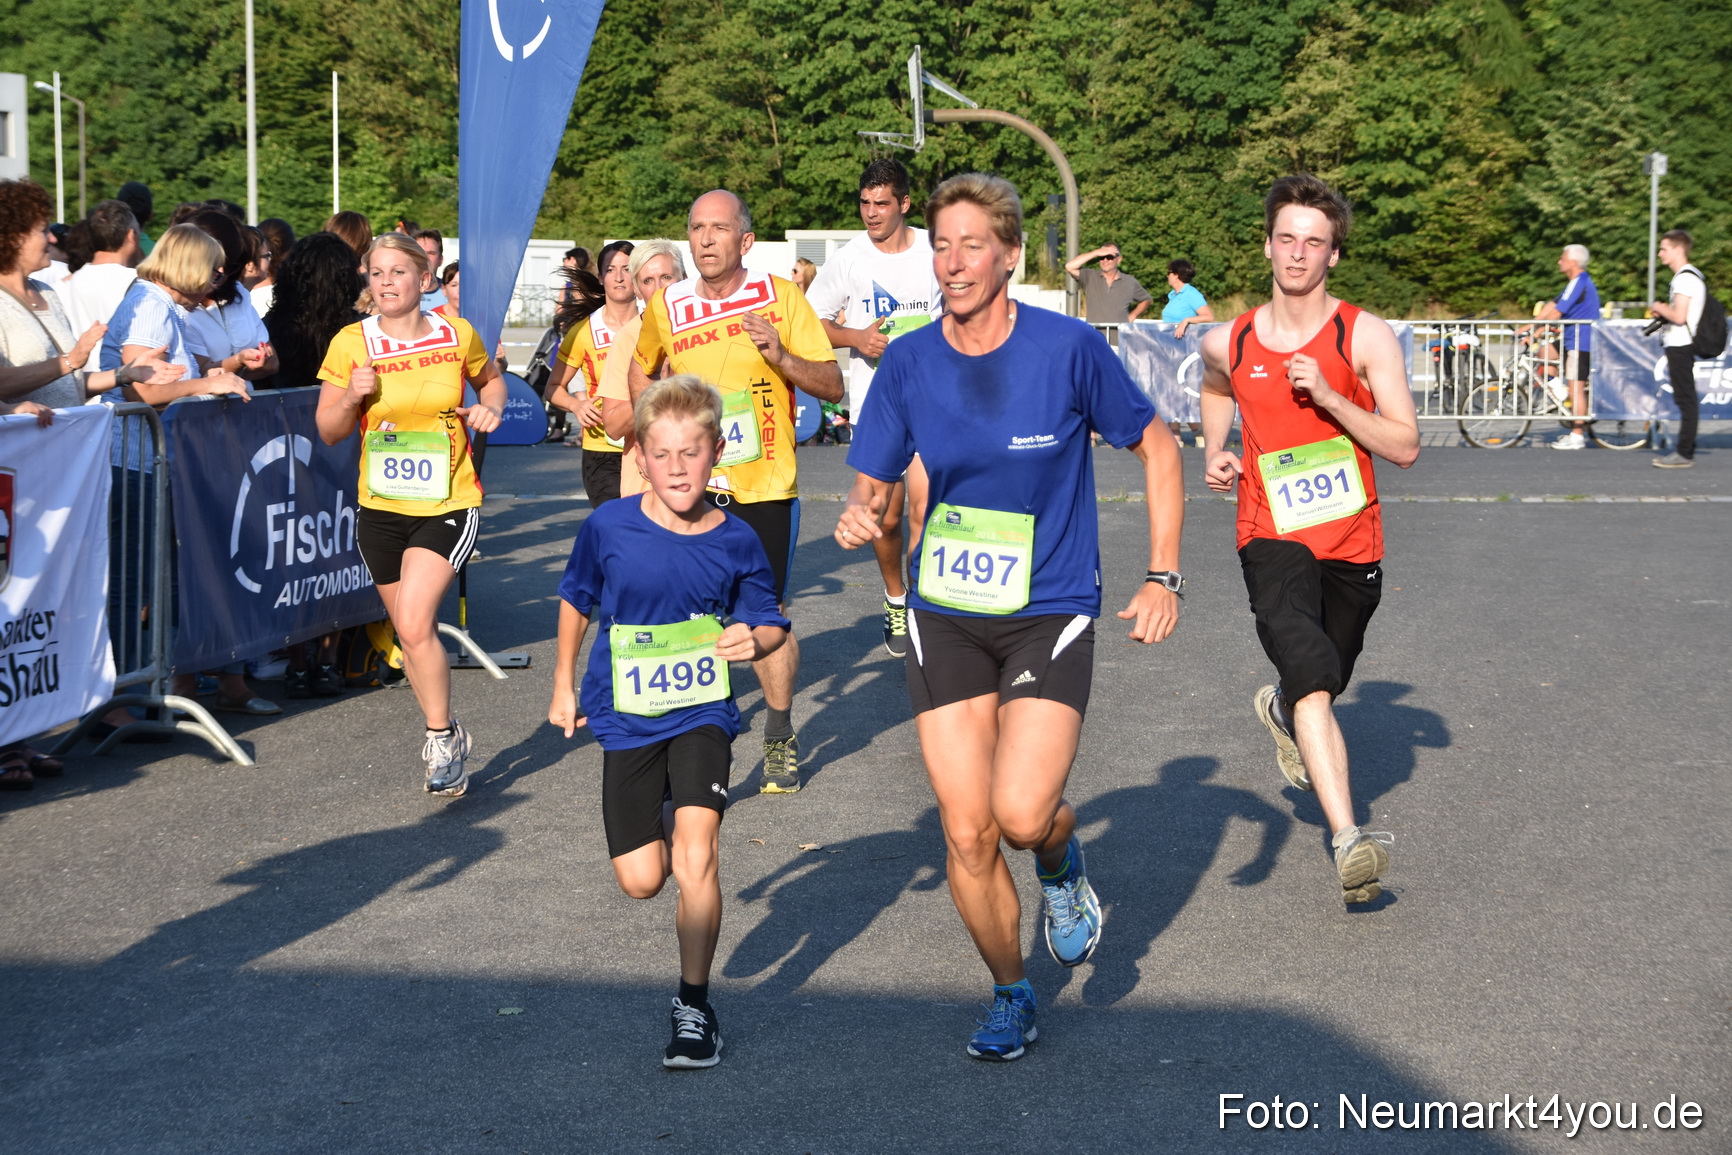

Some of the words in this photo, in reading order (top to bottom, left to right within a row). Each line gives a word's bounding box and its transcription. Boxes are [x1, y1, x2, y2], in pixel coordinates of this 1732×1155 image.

[673, 328, 720, 355] MAX
[418, 352, 462, 368] BÖGL
[1012, 434, 1054, 445] Sport-Team
[383, 457, 433, 482] 890
[1277, 468, 1350, 508] 1391
[265, 490, 356, 571] Fisch
[932, 545, 1019, 587] 1497
[944, 586, 968, 596] Yvonne
[968, 590, 999, 599] Westiner
[628, 640, 669, 650] firmenlauf
[625, 656, 716, 695] 1498
[665, 697, 697, 705] Westiner
